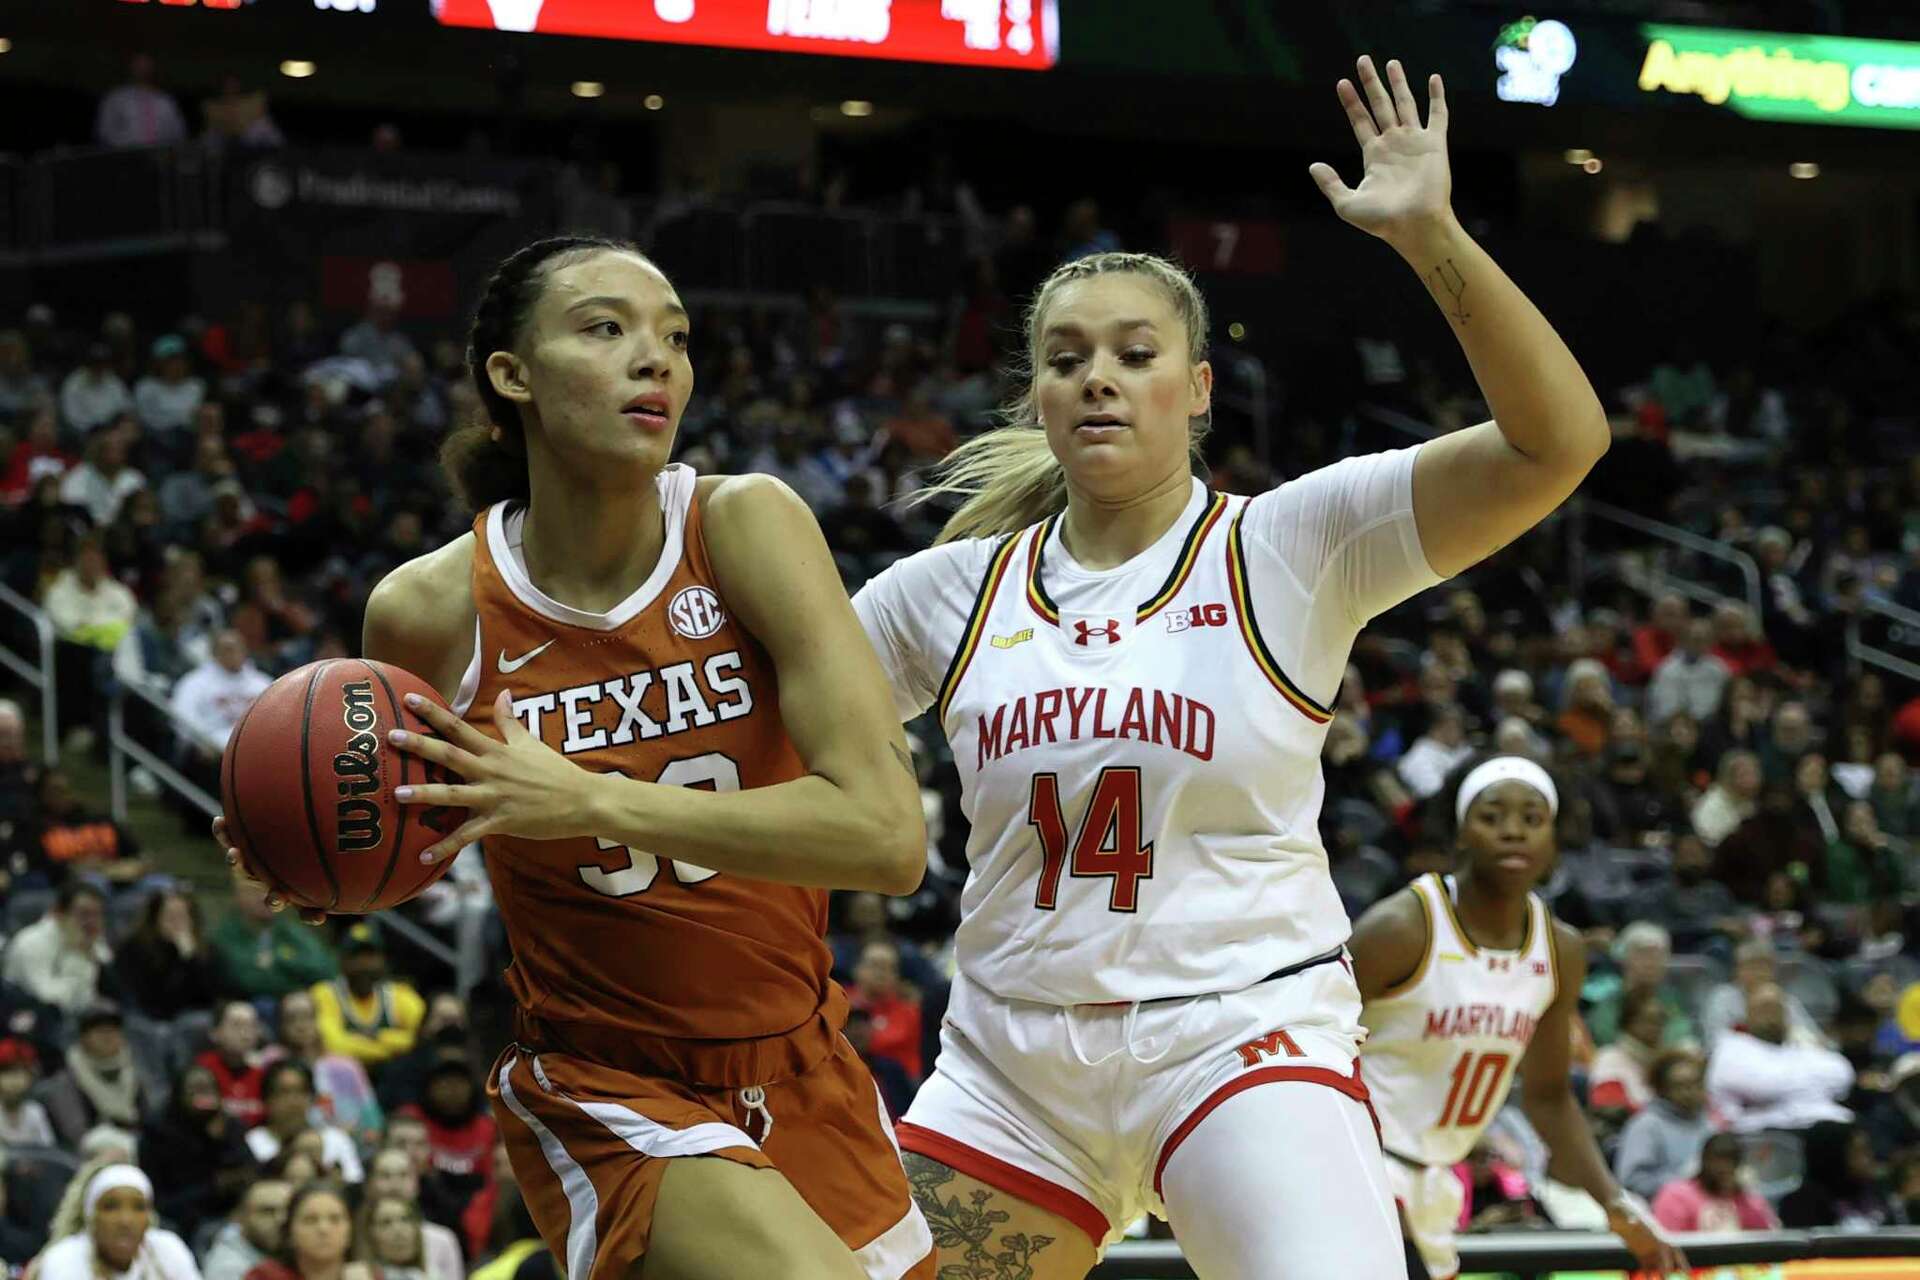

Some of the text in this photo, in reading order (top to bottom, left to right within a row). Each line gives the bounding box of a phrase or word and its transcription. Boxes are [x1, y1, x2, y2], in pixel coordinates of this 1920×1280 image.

[1638, 39, 1849, 112] Anything
[1211, 222, 1240, 269] 7
[369, 261, 403, 307] 8
[671, 587, 721, 635] SEC
[511, 650, 753, 754] TEXAS
[977, 686, 1216, 773] MARYLAND
[333, 678, 384, 853] Wilson
[1028, 766, 1155, 914] 14
[1236, 1028, 1308, 1069] M
[1438, 1051, 1510, 1128] 10
